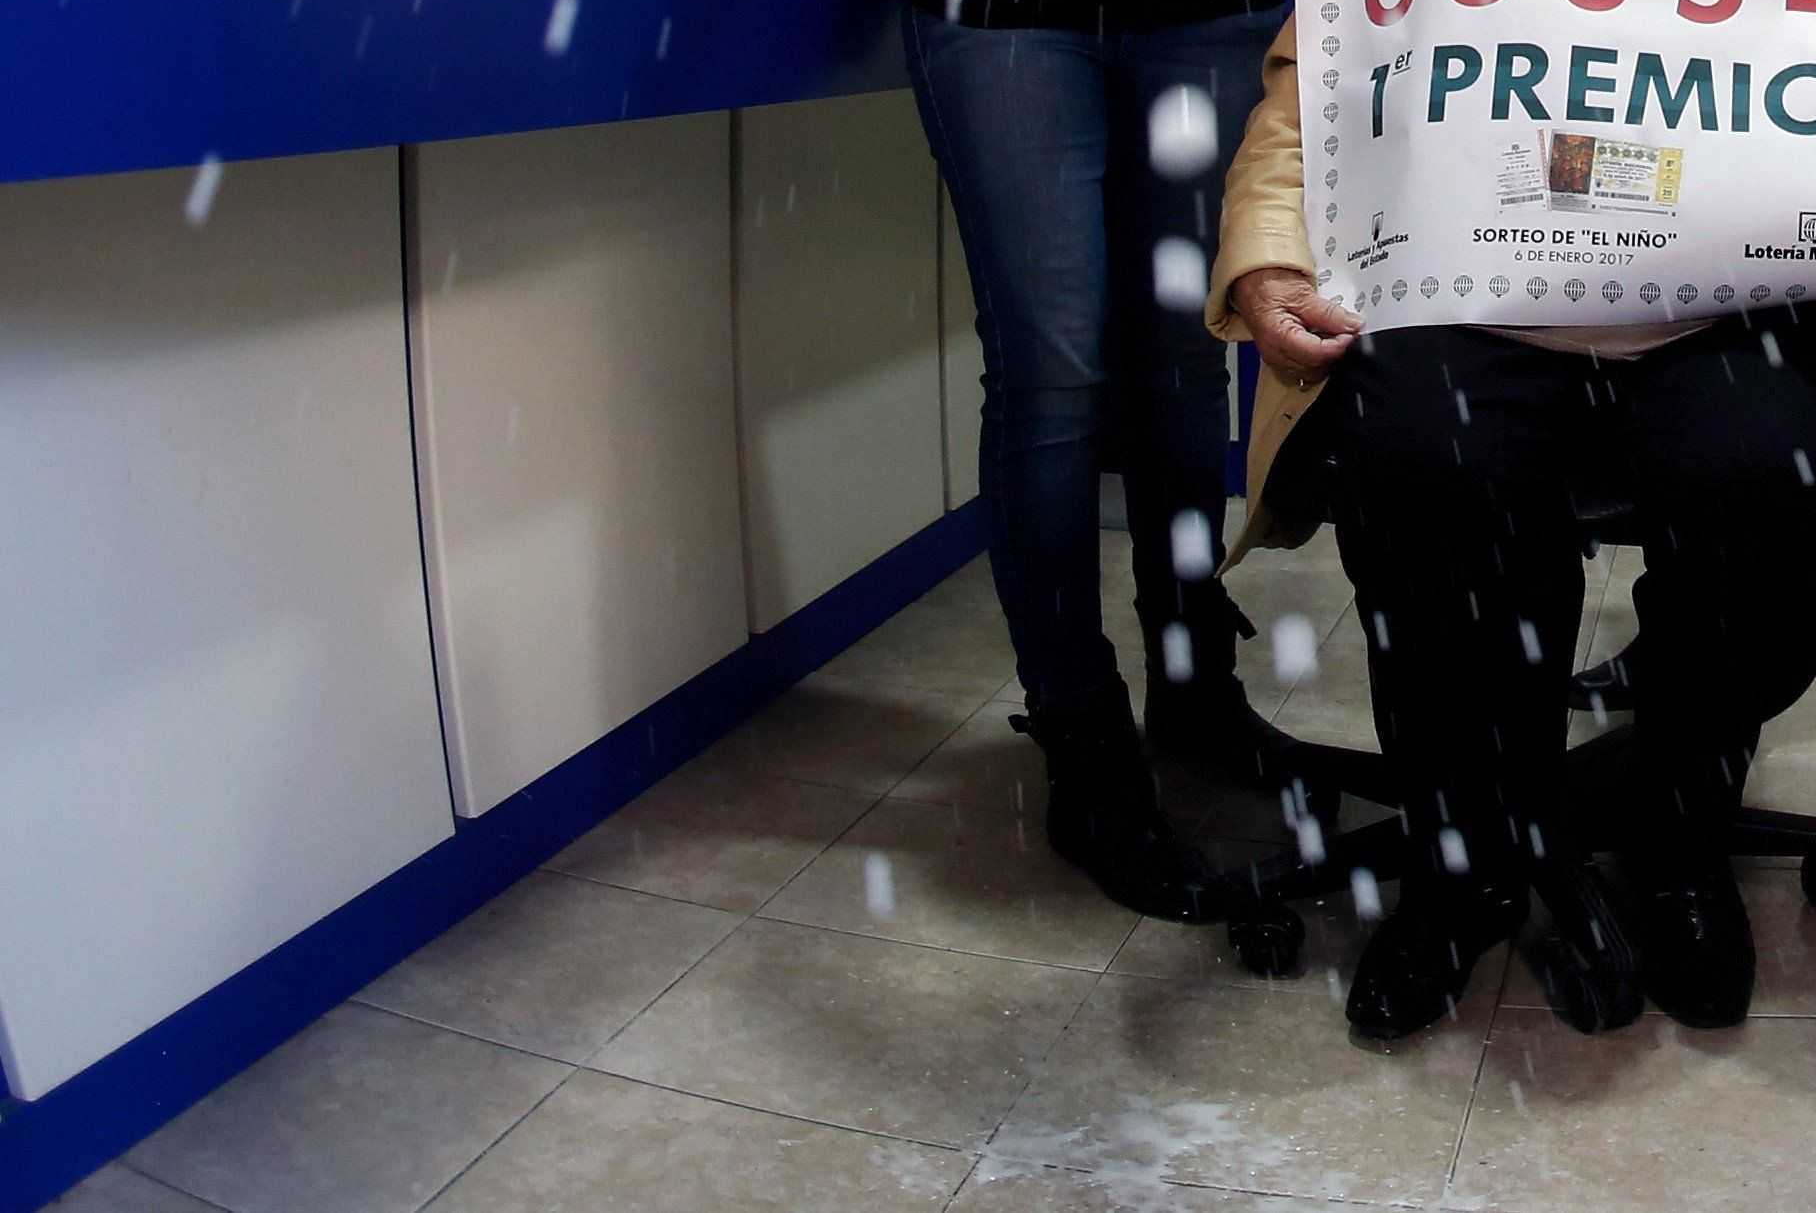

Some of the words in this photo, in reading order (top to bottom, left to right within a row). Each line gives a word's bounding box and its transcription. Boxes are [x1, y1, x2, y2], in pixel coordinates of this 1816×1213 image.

[1377, 234, 1409, 249] Apuestas
[1473, 228, 1546, 245] SORTEO
[1552, 230, 1575, 245] DE
[1581, 229, 1610, 246] "EL
[1616, 228, 1677, 248] NIÑO"
[1514, 250, 1524, 262] 6
[1527, 250, 1546, 262] DE
[1550, 251, 1594, 265] ENERO
[1599, 252, 1635, 266] 2017
[1744, 244, 1806, 260] Lotería
